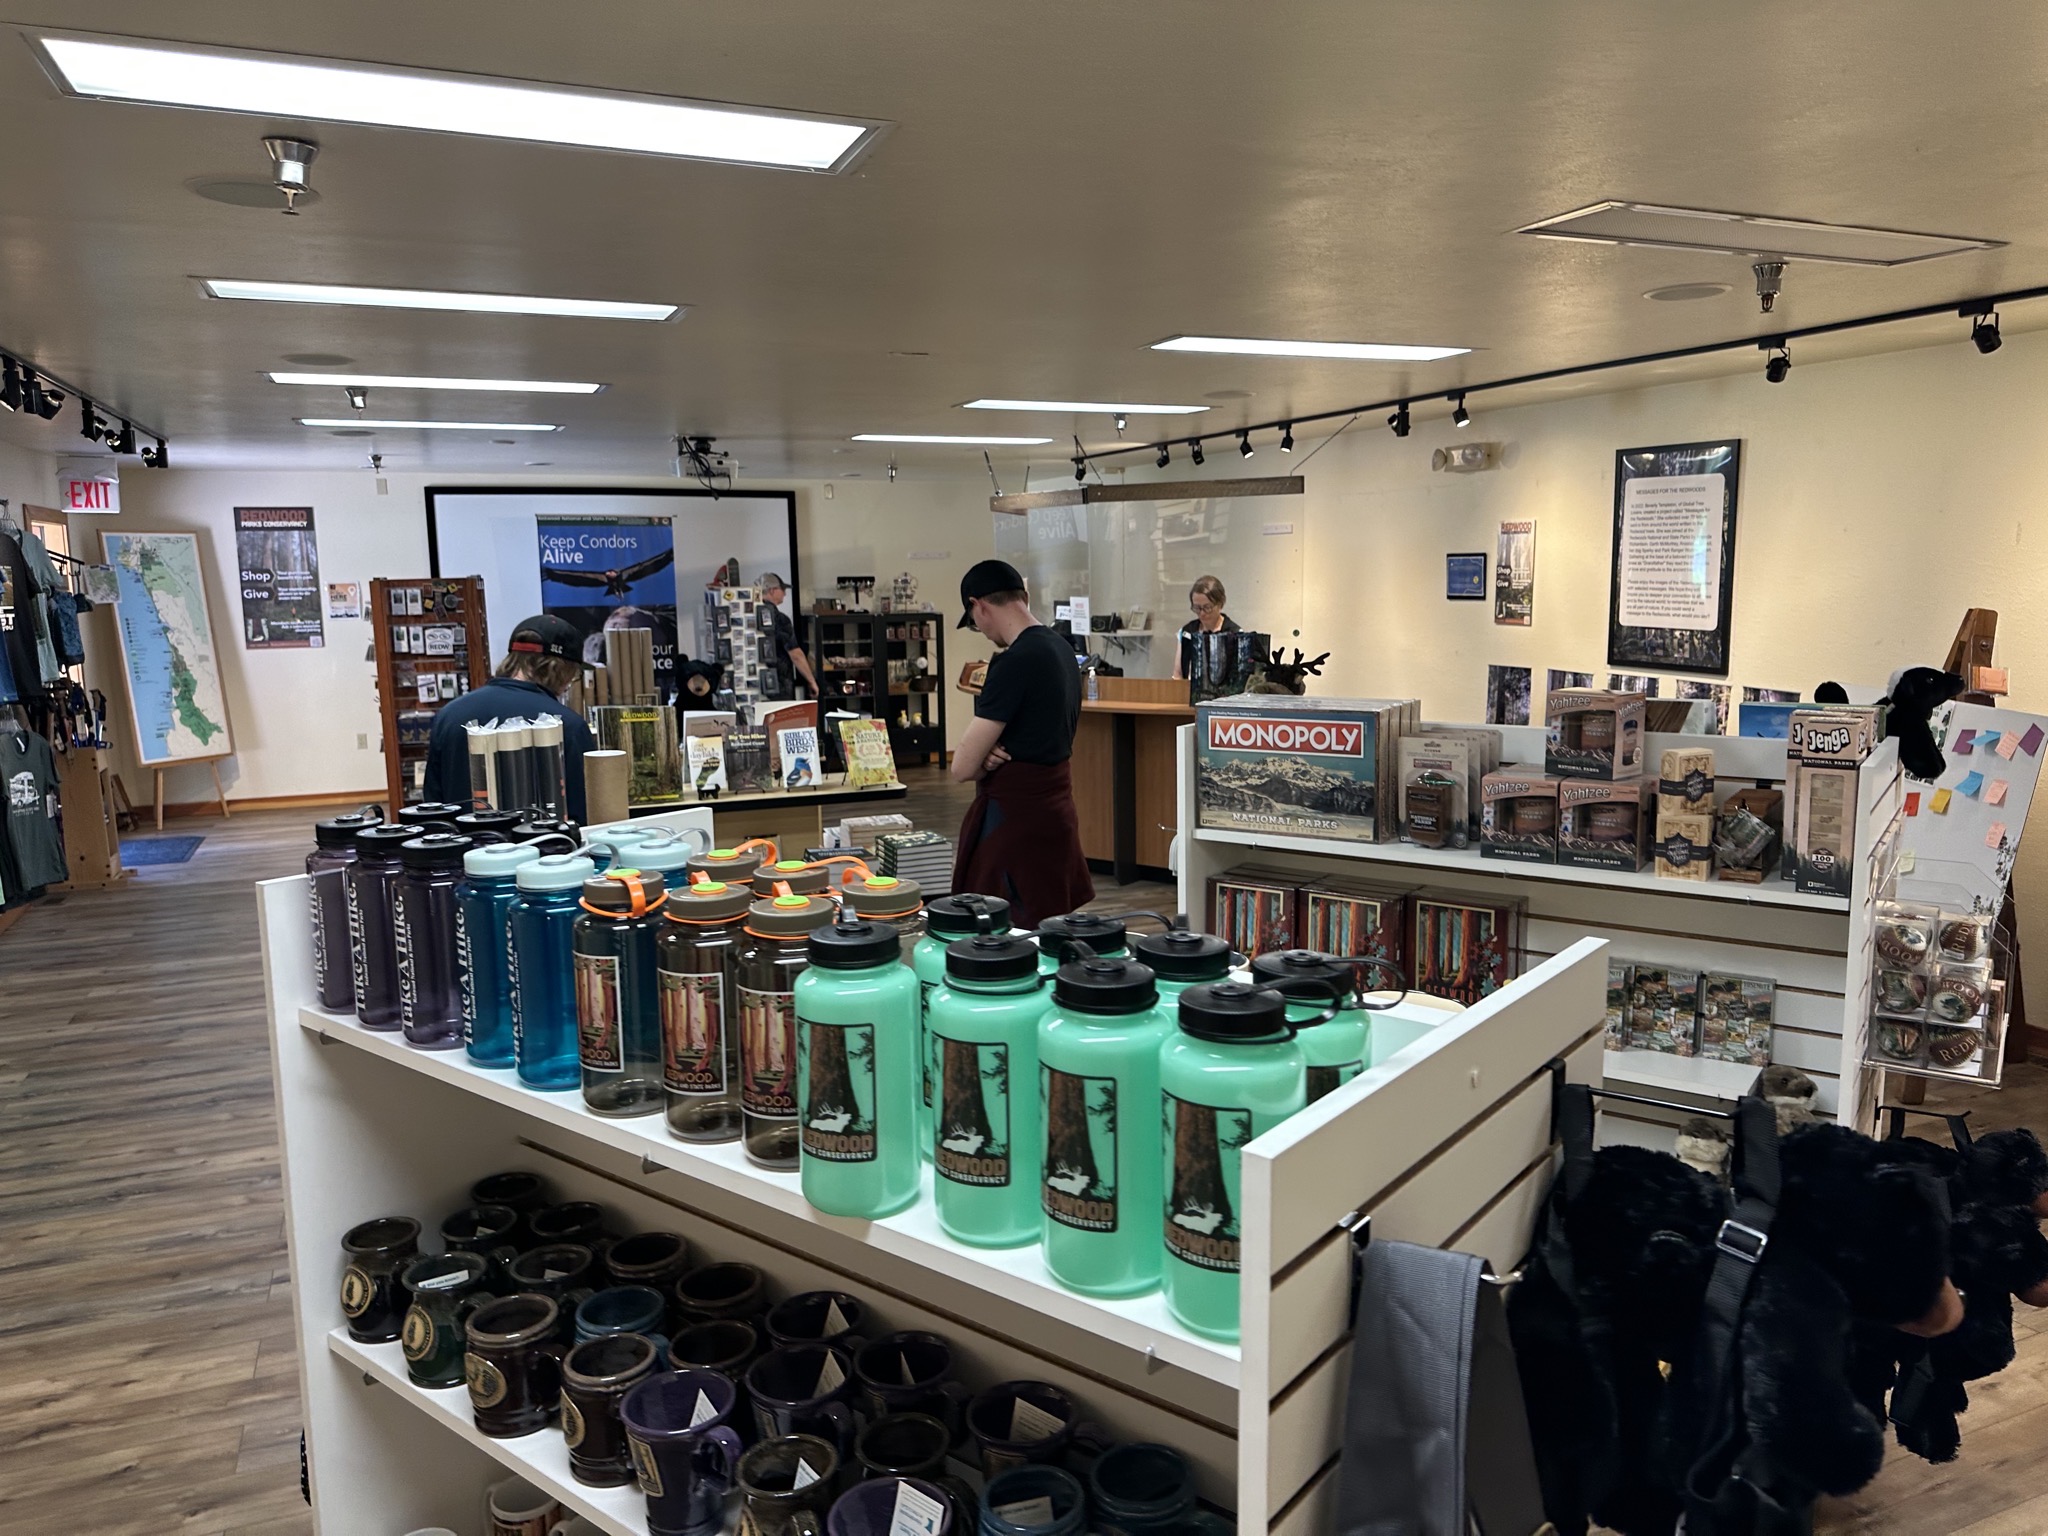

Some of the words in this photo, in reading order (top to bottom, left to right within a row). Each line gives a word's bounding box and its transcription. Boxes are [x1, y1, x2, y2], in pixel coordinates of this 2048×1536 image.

[70, 481, 110, 508] EXIT
[241, 510, 307, 522] REDWOOD
[540, 535, 576, 552] Keep
[580, 534, 637, 548] Condors
[543, 549, 584, 564] Alive
[242, 571, 270, 582] Shop
[1498, 567, 1510, 576] Shop
[244, 589, 268, 598] Give
[550, 644, 563, 654] SLC
[1550, 696, 1591, 710] Yahtzee
[784, 730, 813, 740] SIBLEY
[786, 738, 815, 747] BIRDS
[1214, 722, 1359, 751] MONOPOLY
[1808, 728, 1850, 752] Jenga
[786, 746, 814, 754] WEST
[1485, 782, 1530, 796] Yahtzee
[1564, 788, 1611, 802] Yahtzee
[1232, 812, 1292, 827] NATIONAL
[1298, 818, 1338, 830] PARKS
[349, 883, 360, 938] Hike.
[394, 896, 408, 954] Hike.
[312, 930, 321, 946] A
[456, 907, 467, 967] Hike.
[351, 944, 361, 960] A
[506, 921, 515, 982] Hike.
[314, 948, 325, 993] Take
[398, 960, 409, 976] A
[354, 963, 366, 1009] Take
[459, 973, 470, 991] A
[401, 979, 414, 1029] Take
[510, 990, 518, 1008] A
[462, 994, 473, 1045] Take
[666, 1068, 714, 1083] REDWOOD
[744, 1090, 792, 1106] REDWOOD
[802, 1129, 874, 1154] REDWOOD
[818, 1149, 873, 1160] CONSERVANCY
[936, 1147, 1007, 1176] REDWOOD
[950, 1170, 1006, 1184] CONSERVANCY
[1055, 1210, 1114, 1230] CONSERVANCY
[1182, 1250, 1240, 1270] CONSERVANC
